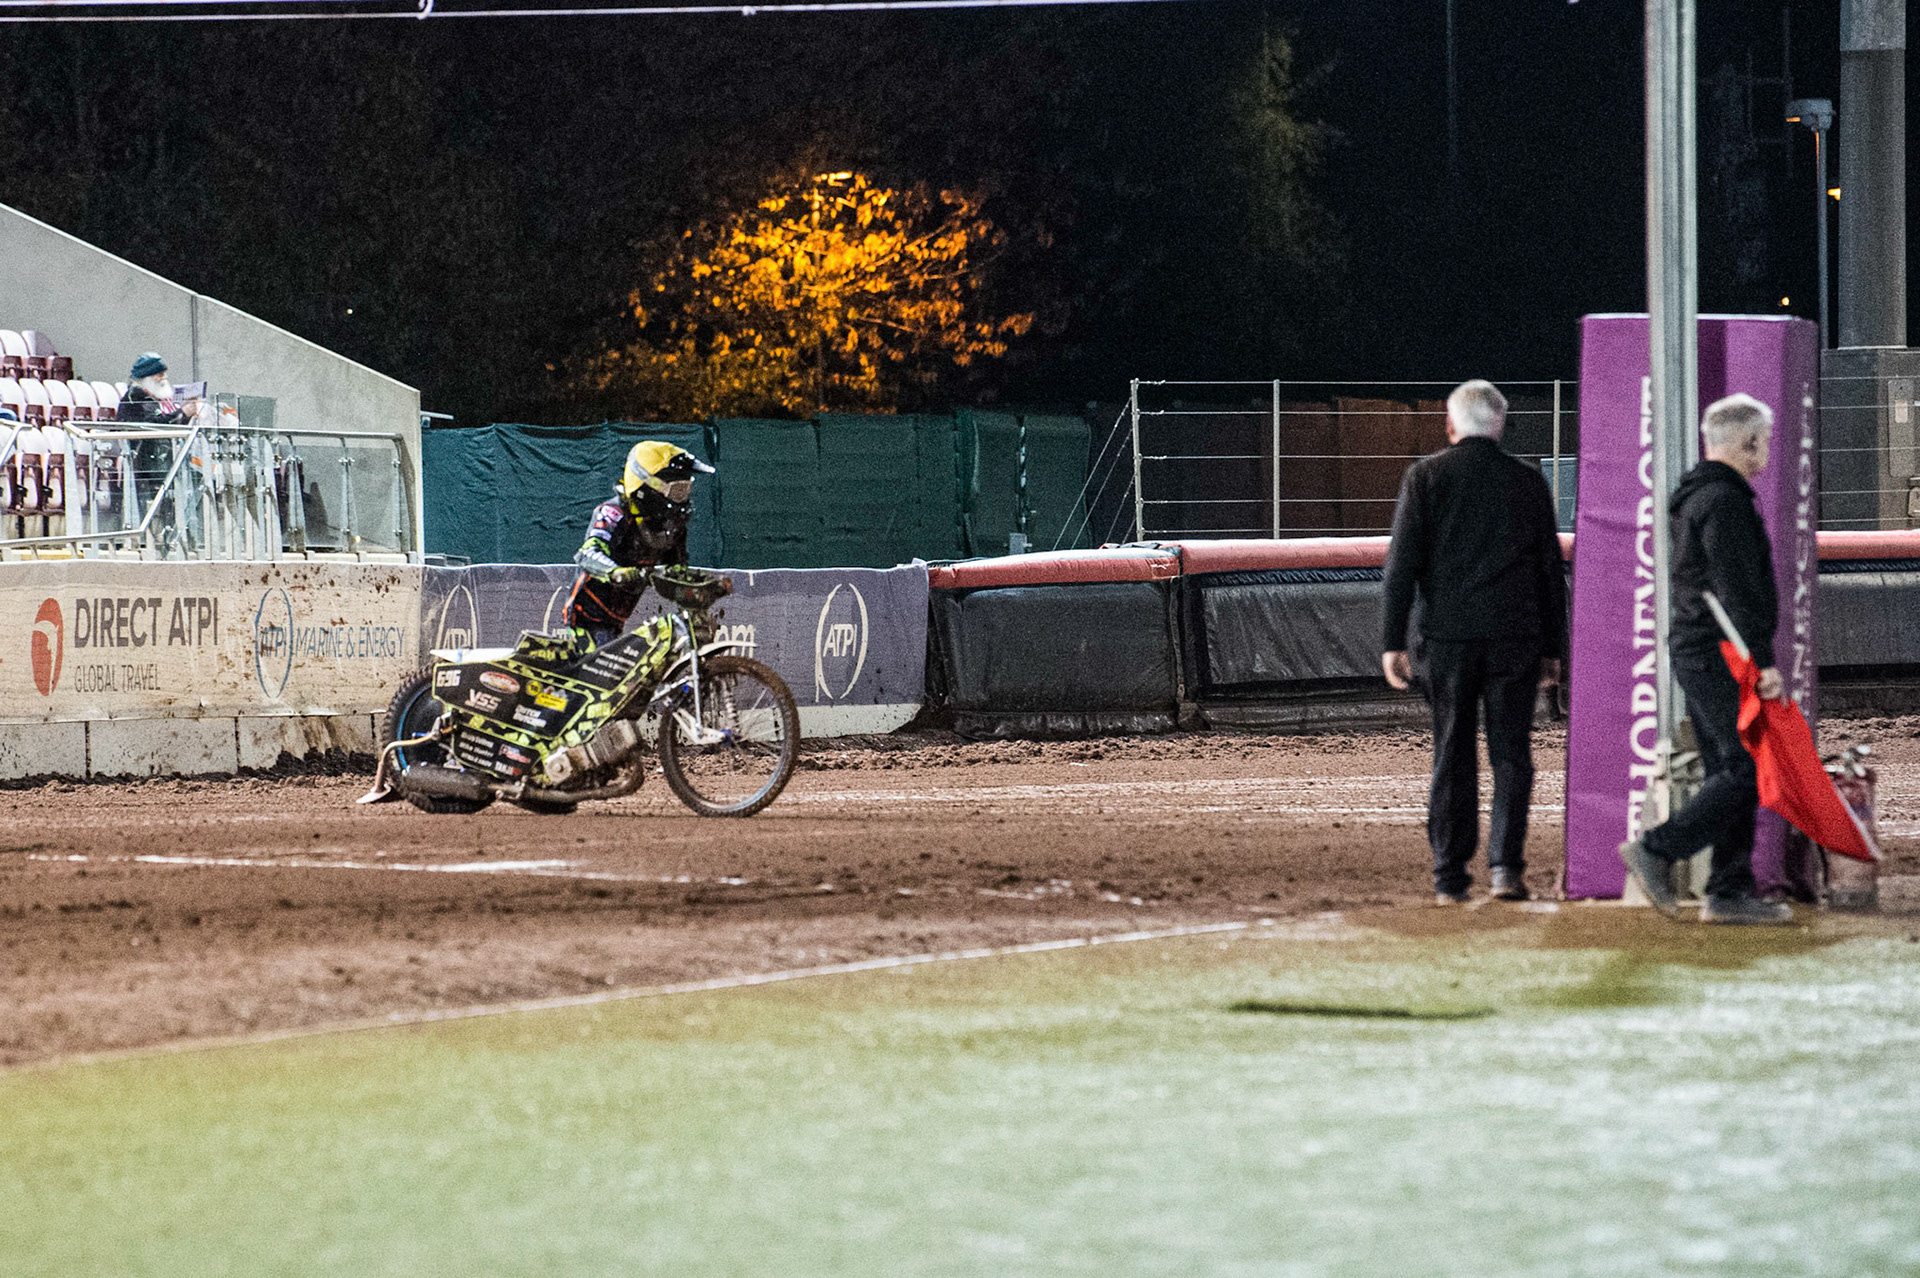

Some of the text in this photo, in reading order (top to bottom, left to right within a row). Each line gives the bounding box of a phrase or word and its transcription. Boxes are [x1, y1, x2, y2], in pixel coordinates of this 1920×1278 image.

[74, 597, 219, 648] DIRECT ATPI
[1627, 376, 1660, 842] THORNEYC
[260, 627, 288, 658] ATPI
[295, 627, 405, 658] MARINE & ENERGY
[823, 623, 858, 657] ATPI
[74, 663, 161, 693] GLOBAL TRAVEL
[436, 670, 461, 687] 696
[465, 689, 502, 711] VSS
